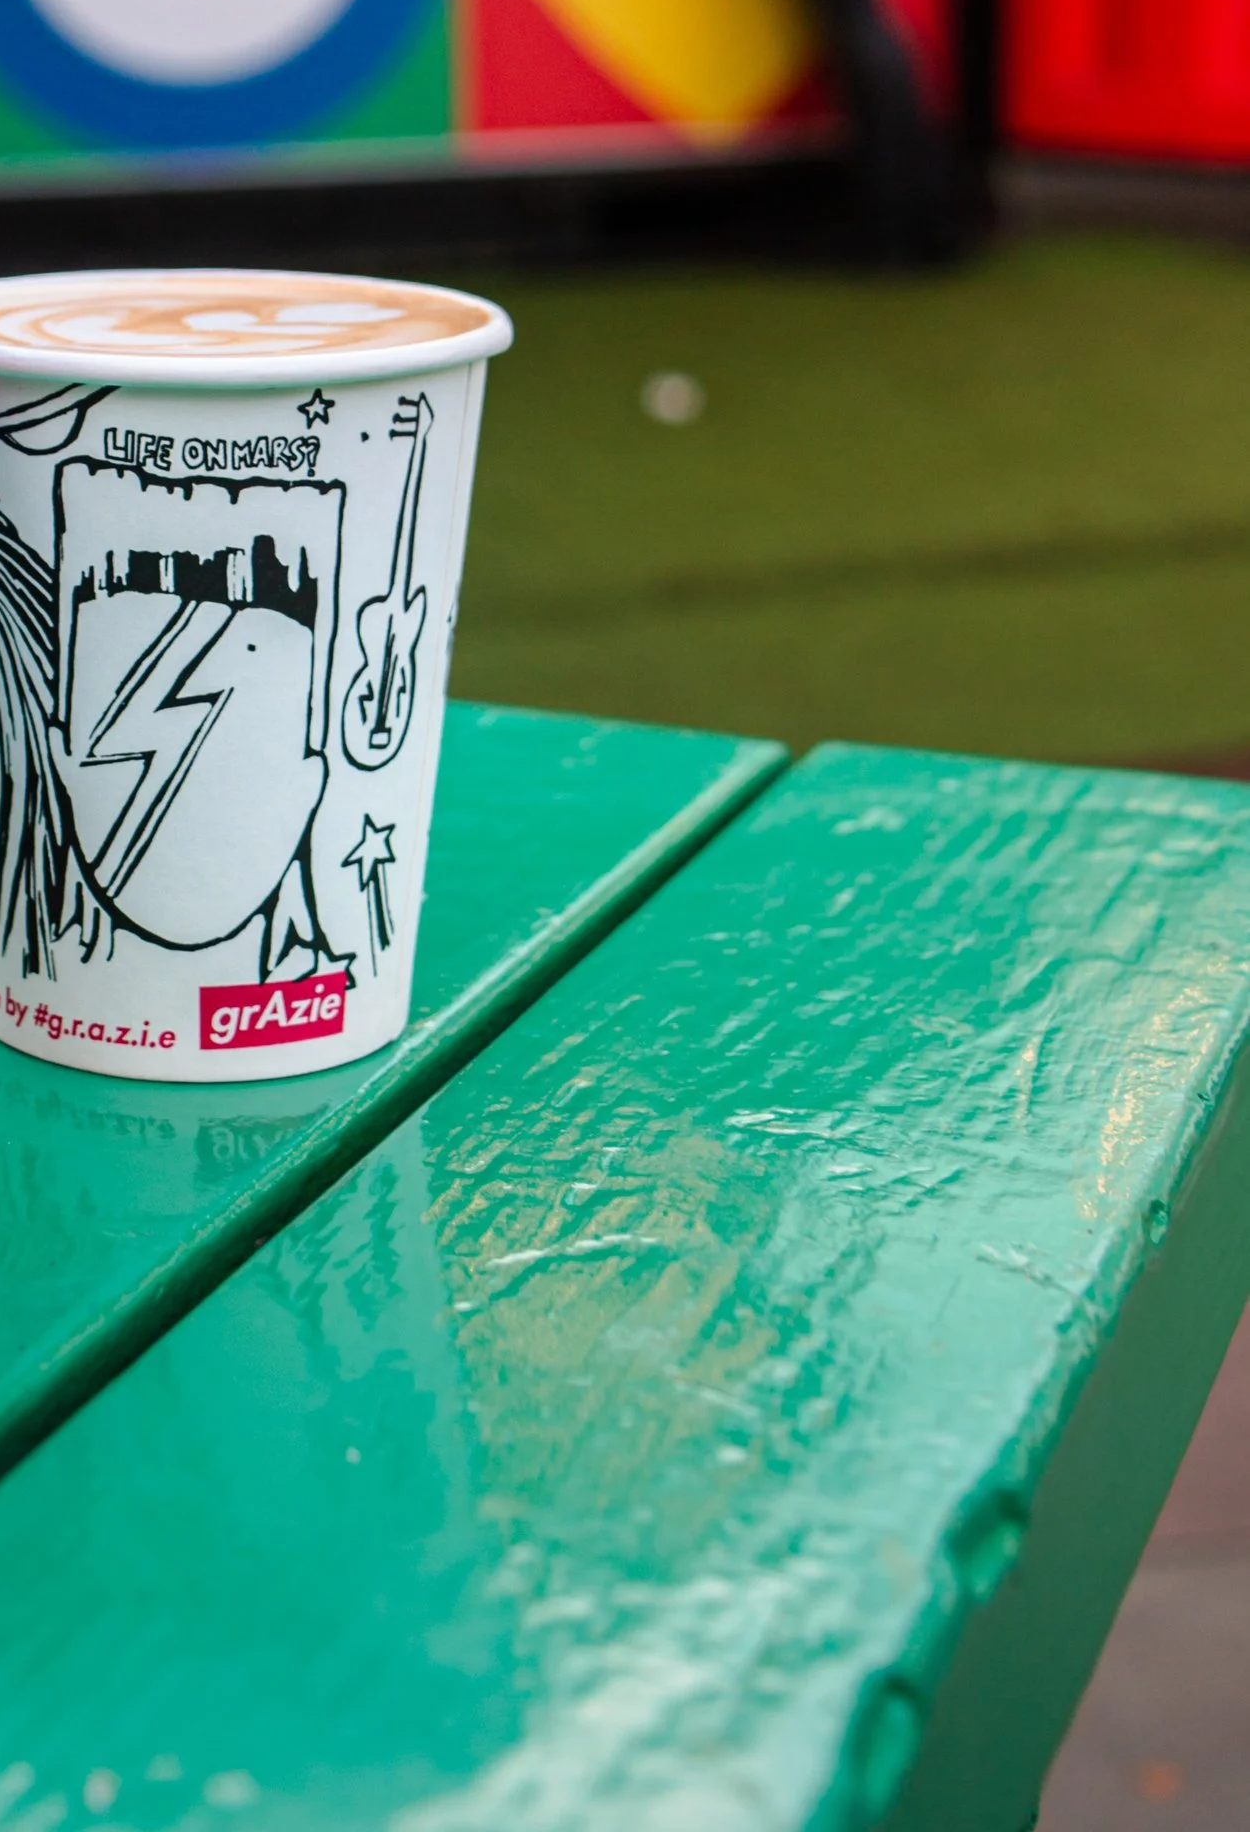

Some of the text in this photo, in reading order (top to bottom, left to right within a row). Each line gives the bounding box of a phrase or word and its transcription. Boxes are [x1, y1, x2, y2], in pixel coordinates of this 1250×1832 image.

[104, 427, 322, 477] LIFE ON MARS?
[6, 986, 28, 1027] by
[33, 1002, 177, 1050] #g.r.a.z.i.e
[209, 982, 343, 1045] grAzie
